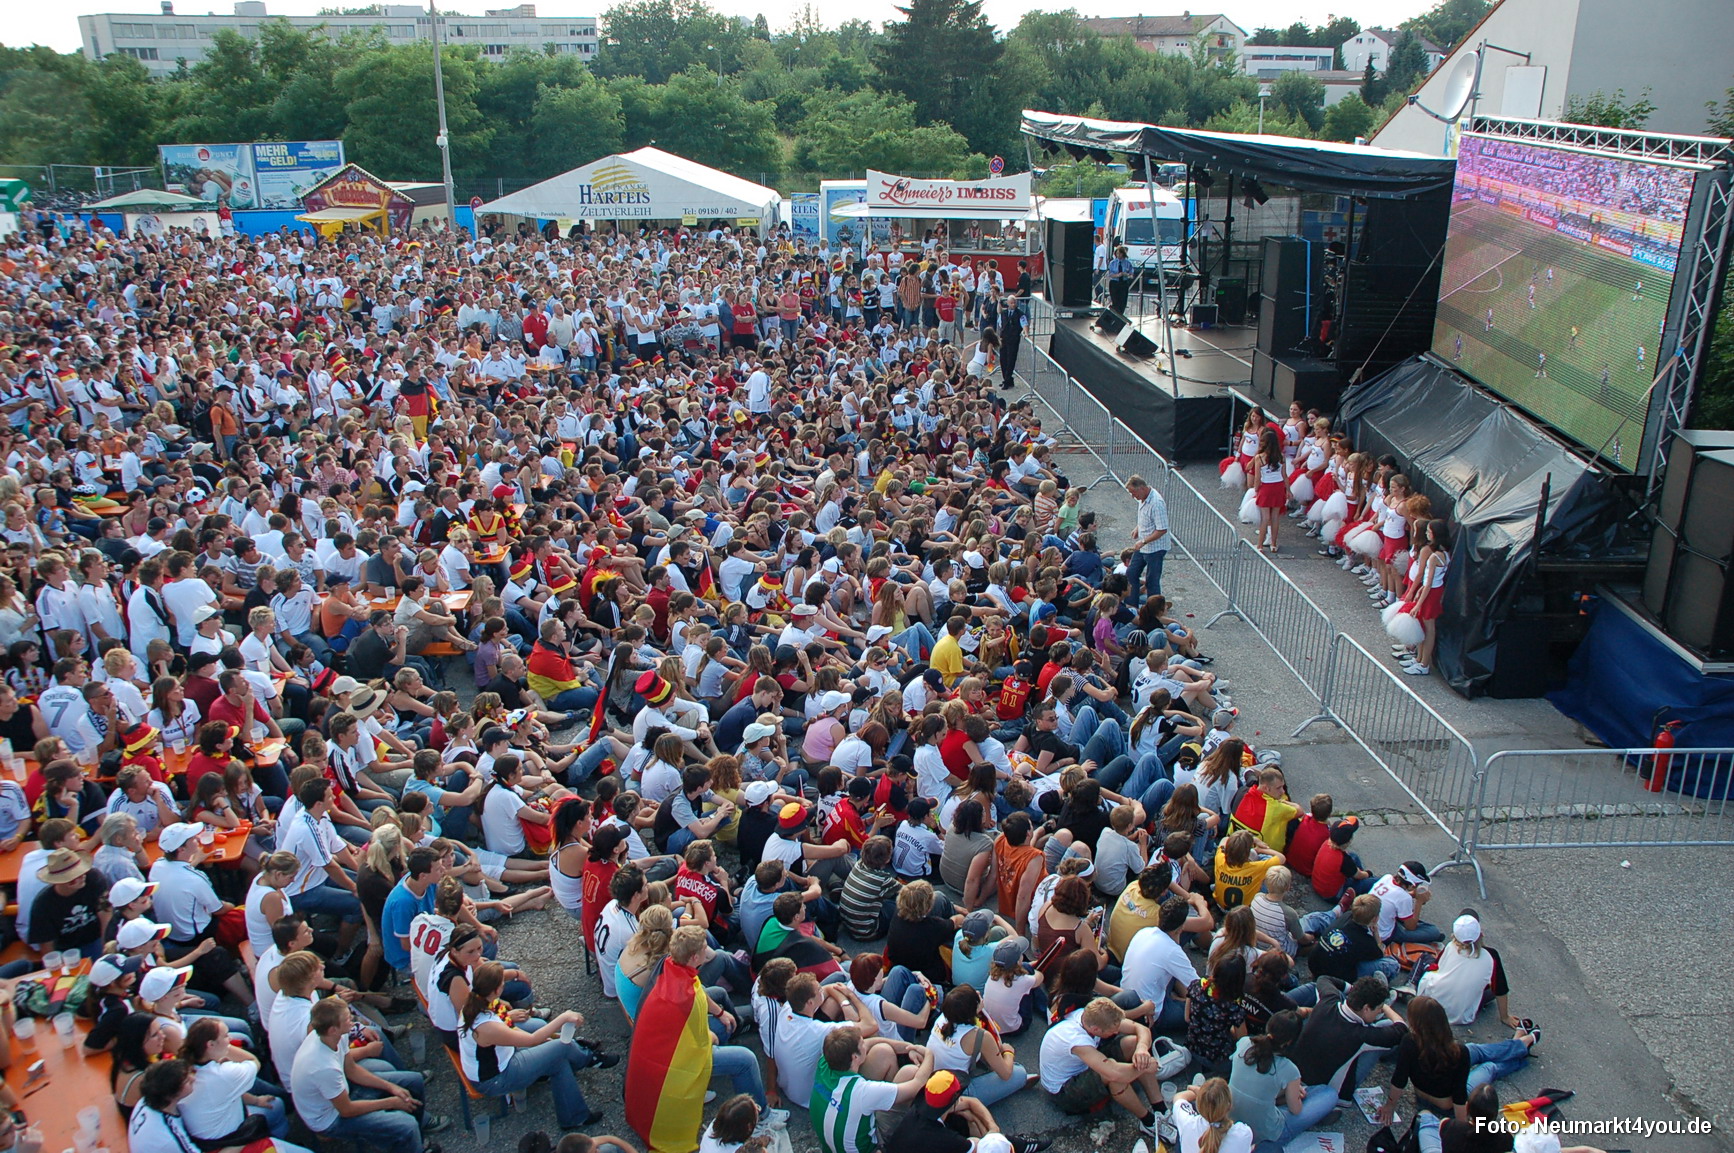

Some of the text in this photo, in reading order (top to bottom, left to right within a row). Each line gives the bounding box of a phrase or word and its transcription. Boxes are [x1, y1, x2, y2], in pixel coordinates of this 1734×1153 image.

[255, 145, 288, 156] MEHR
[270, 156, 298, 166] GELD!
[579, 184, 651, 204] HÄRTEIS
[957, 187, 1017, 200] IMBISS
[580, 206, 652, 216] ZELTVERLEIH
[1002, 692, 1017, 707] 11
[50, 702, 69, 728] 7
[896, 839, 911, 869] 7
[1374, 882, 1389, 897] 13
[413, 923, 443, 957] 10
